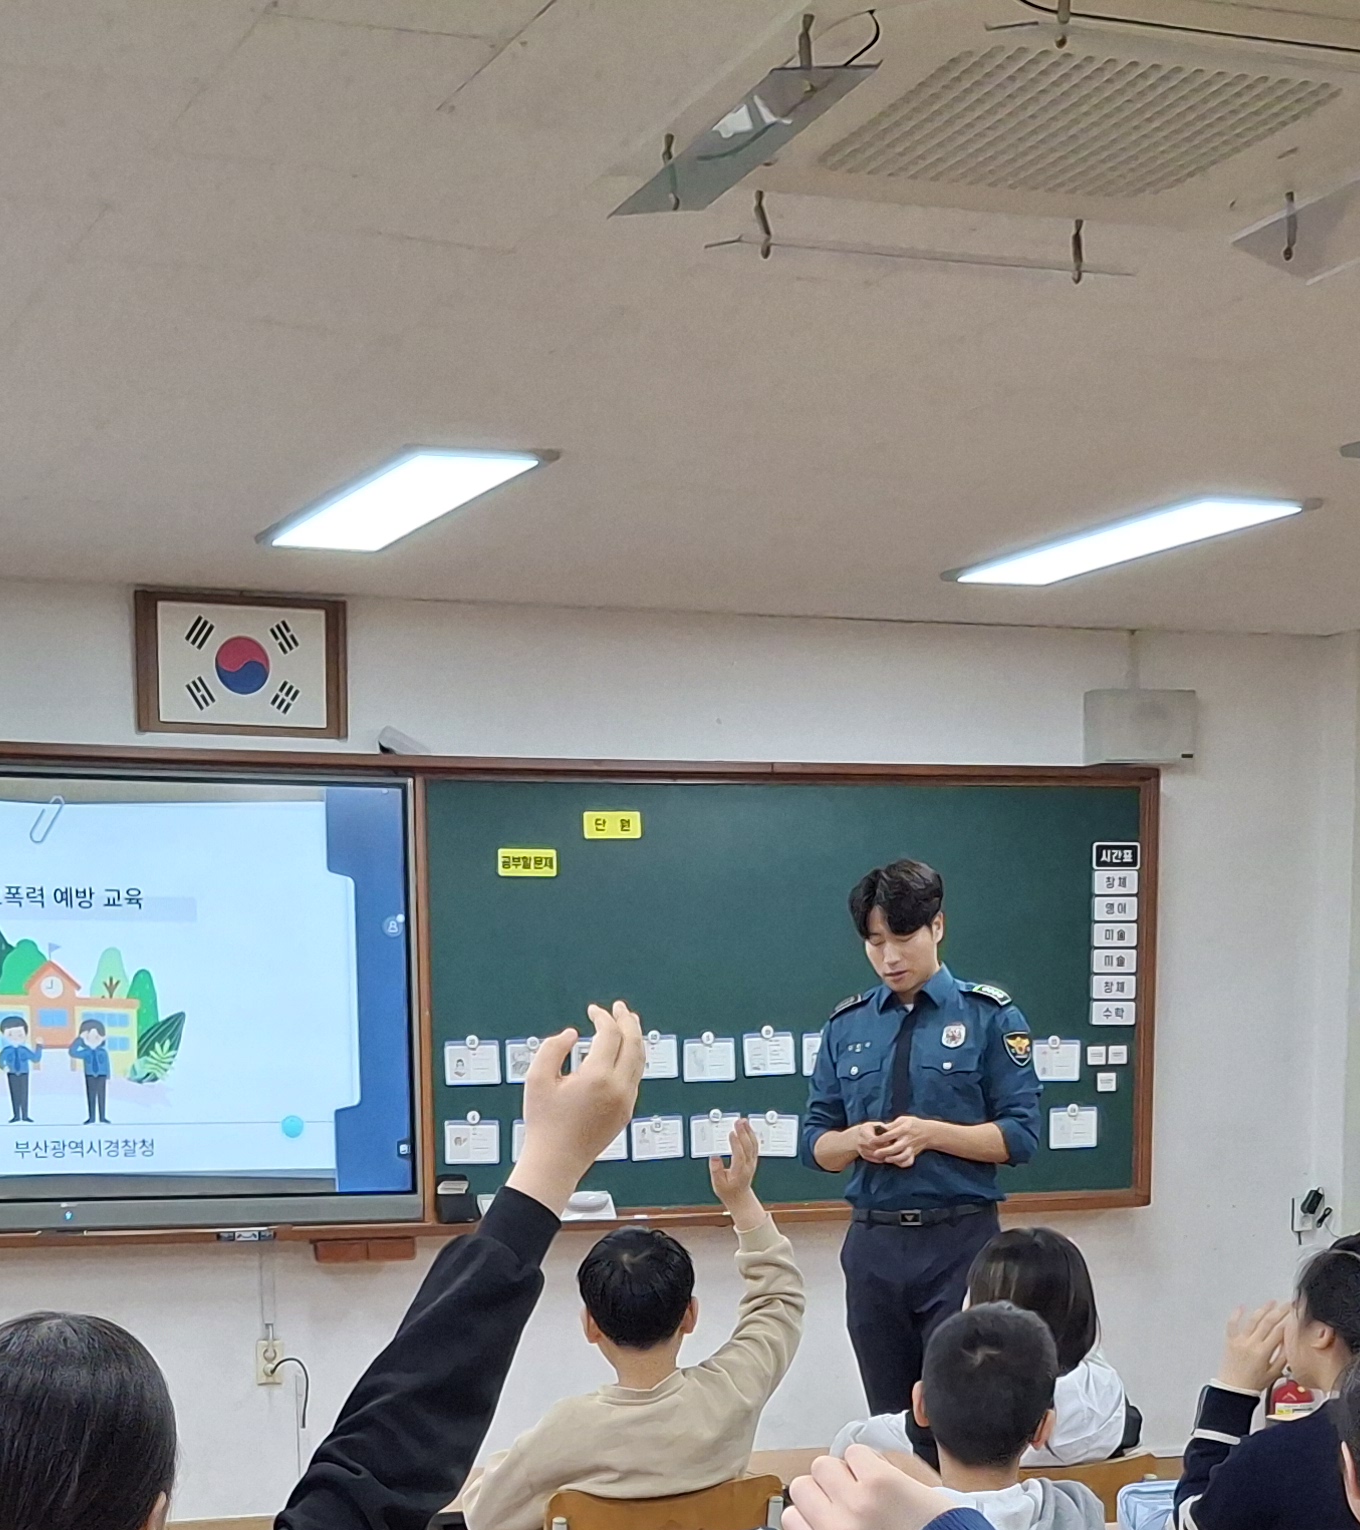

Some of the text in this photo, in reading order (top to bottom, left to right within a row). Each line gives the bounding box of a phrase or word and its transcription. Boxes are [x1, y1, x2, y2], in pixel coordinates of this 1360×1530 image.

[1100, 849, 1133, 862] 시간표
[53, 886, 95, 909] 예방
[103, 887, 144, 910] 교육
[14, 1138, 155, 1159] 부산광역시경찰청
